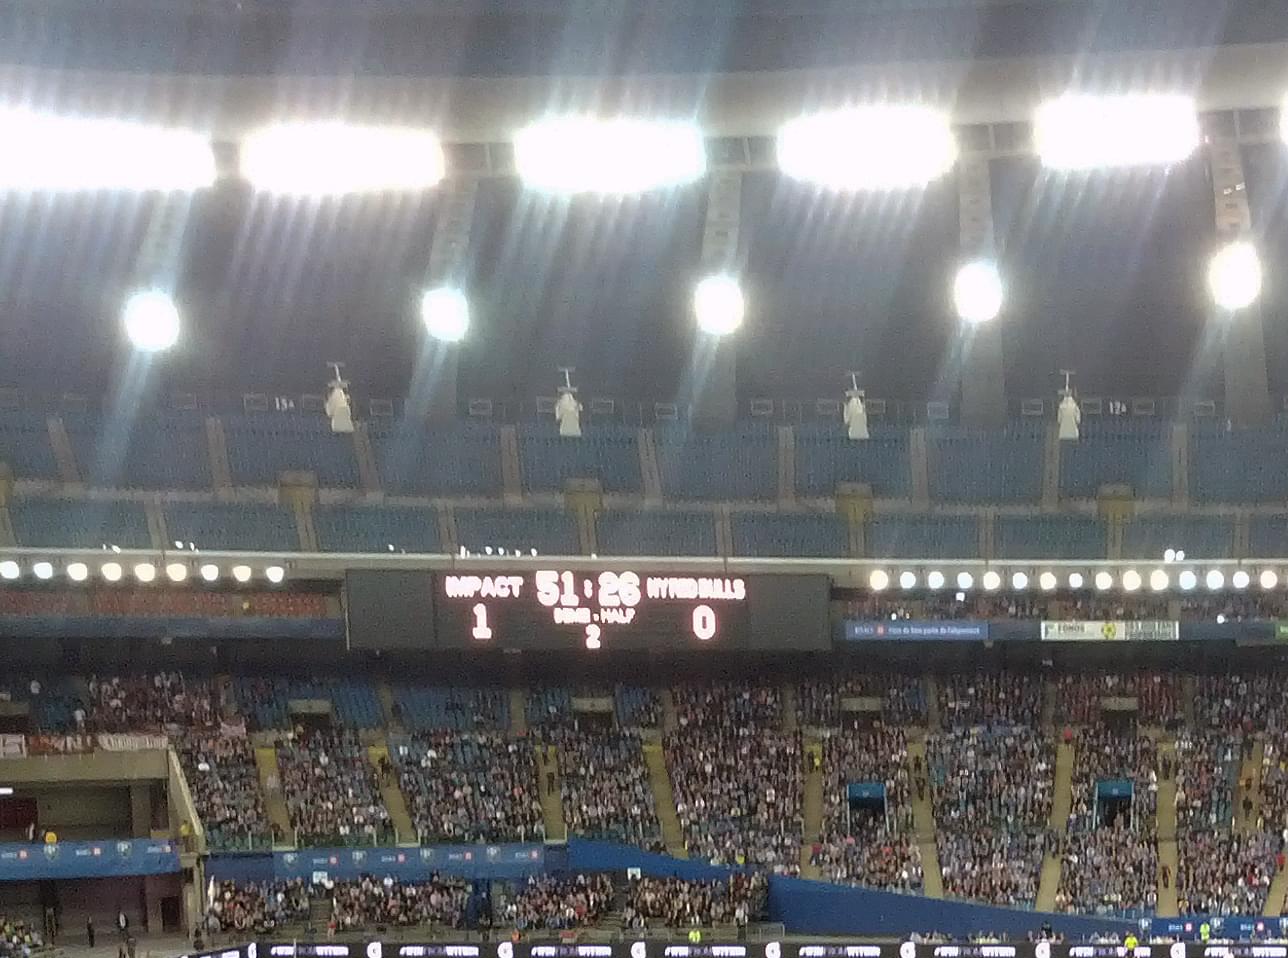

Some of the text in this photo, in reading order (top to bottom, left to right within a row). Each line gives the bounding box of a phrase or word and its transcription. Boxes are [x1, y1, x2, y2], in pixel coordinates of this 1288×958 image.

[445, 576, 524, 598] IMPACT
[536, 570, 641, 607] 51:26
[472, 603, 493, 639] 1
[601, 608, 635, 624] HALF
[692, 604, 716, 640] 0
[585, 624, 601, 649] 2
